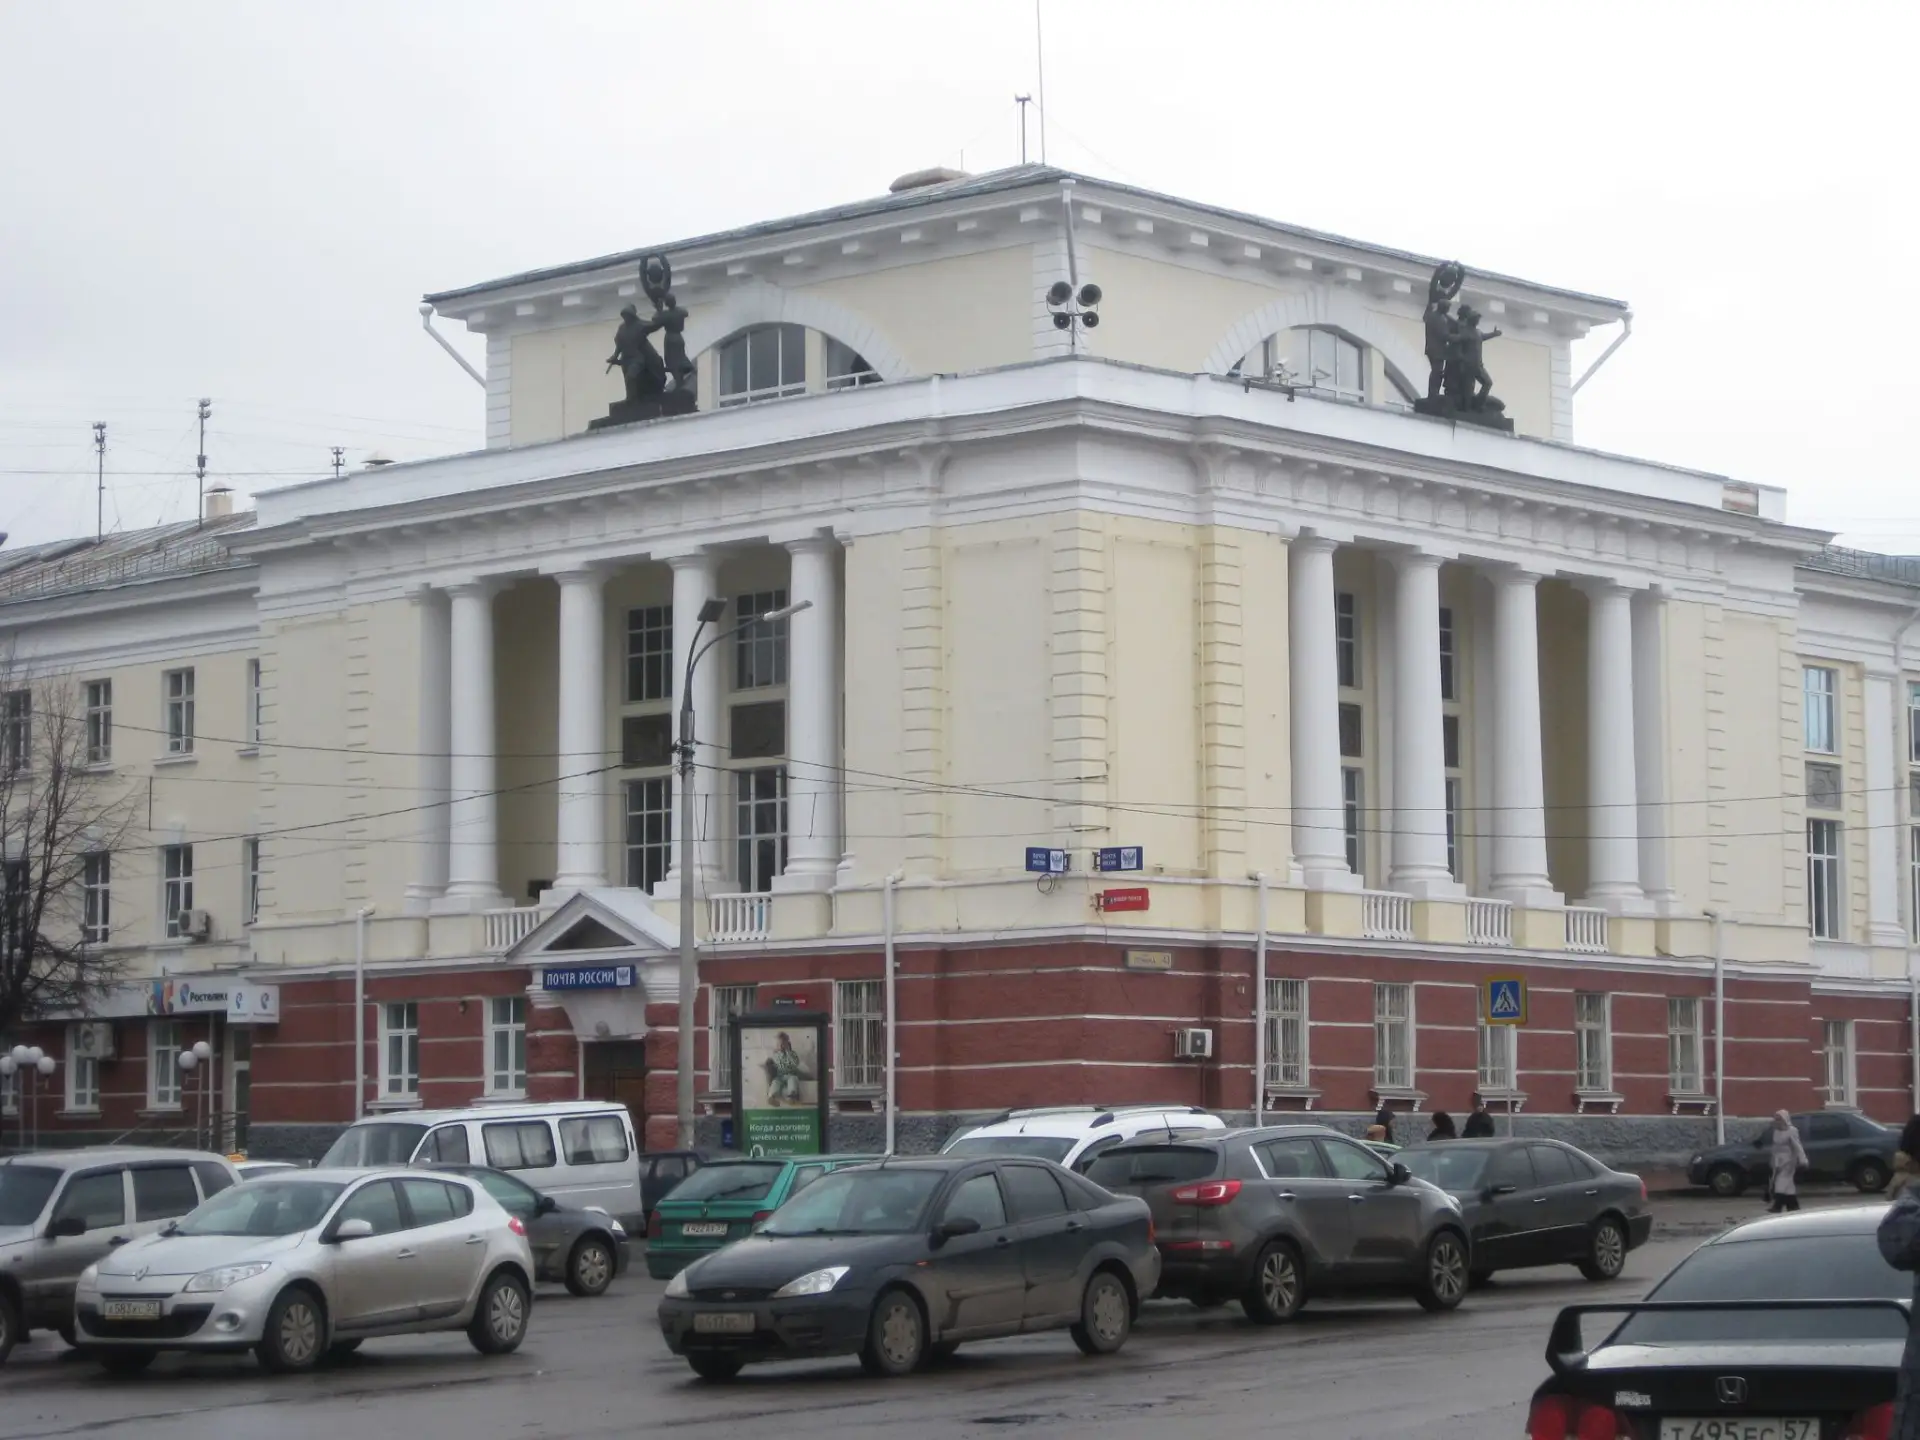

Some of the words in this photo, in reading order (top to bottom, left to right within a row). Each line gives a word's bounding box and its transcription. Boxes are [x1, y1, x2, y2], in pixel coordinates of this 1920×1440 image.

[546, 972, 576, 986] ПОЧТА
[579, 970, 614, 984] РОССИИ
[749, 1124, 774, 1132] Когда
[775, 1124, 811, 1133] разговор
[1784, 1420, 1811, 1440] 57
